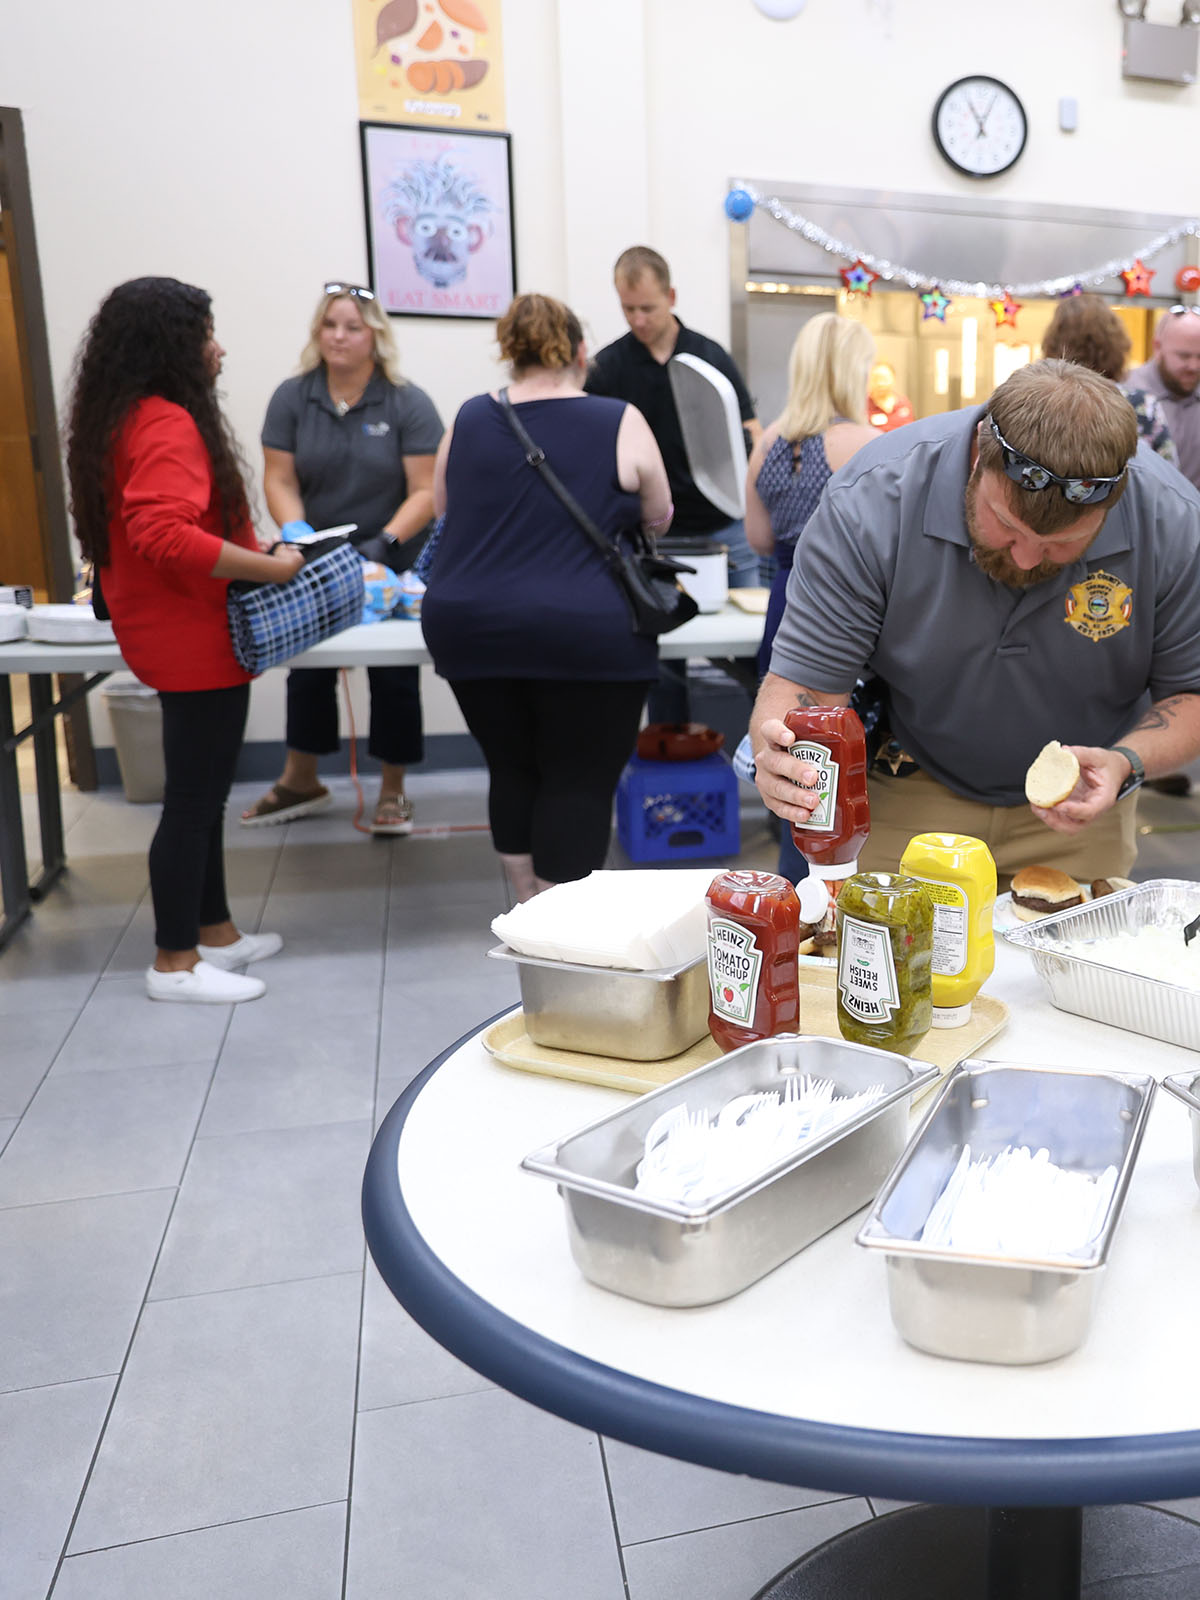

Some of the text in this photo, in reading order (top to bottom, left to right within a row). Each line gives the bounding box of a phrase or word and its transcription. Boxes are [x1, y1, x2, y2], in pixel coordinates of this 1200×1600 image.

[389, 290, 501, 309] EAT SMART
[795, 750, 821, 763] HEINZ
[716, 929, 745, 949] HEINZ
[713, 945, 750, 971] TOMATO
[714, 961, 748, 981] KETCHUP
[849, 964, 878, 981] RELISH
[850, 976, 878, 992] SWEET
[848, 994, 880, 1013] HEINZ
